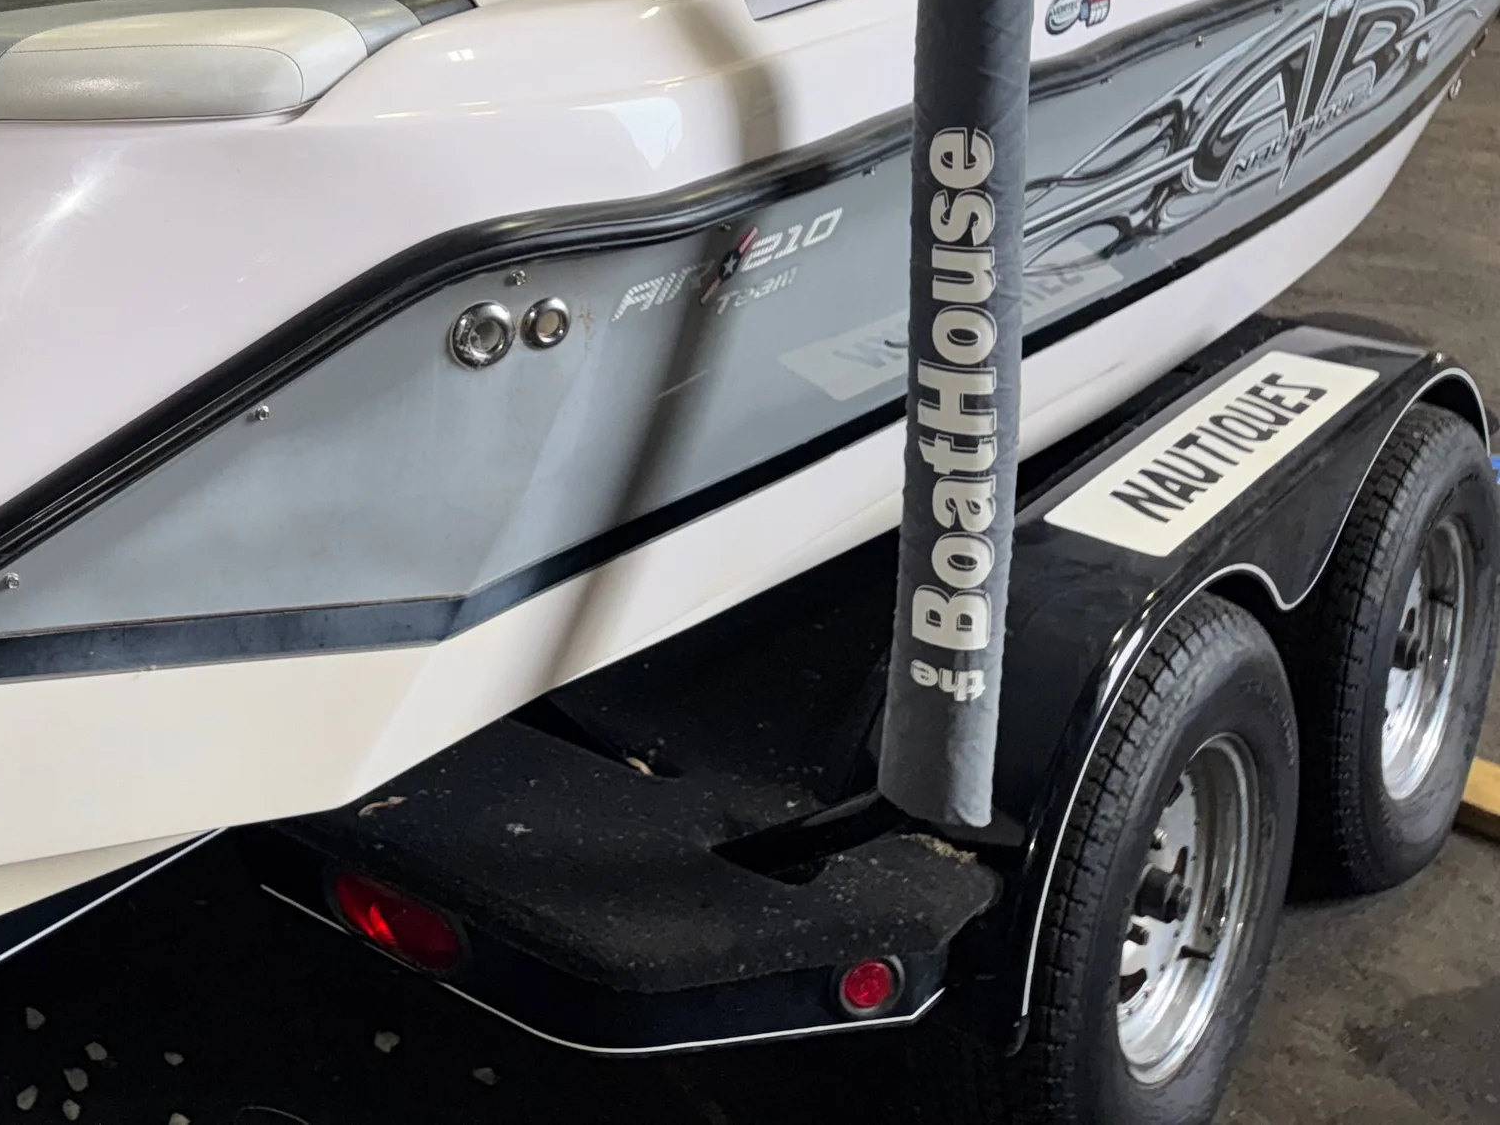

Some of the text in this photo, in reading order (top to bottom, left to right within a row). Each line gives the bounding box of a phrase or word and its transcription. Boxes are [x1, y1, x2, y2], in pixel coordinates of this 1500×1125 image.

[739, 206, 844, 273] 210
[910, 126, 999, 702] the BoatHouse
[1109, 372, 1328, 525] NAUTIQUES
